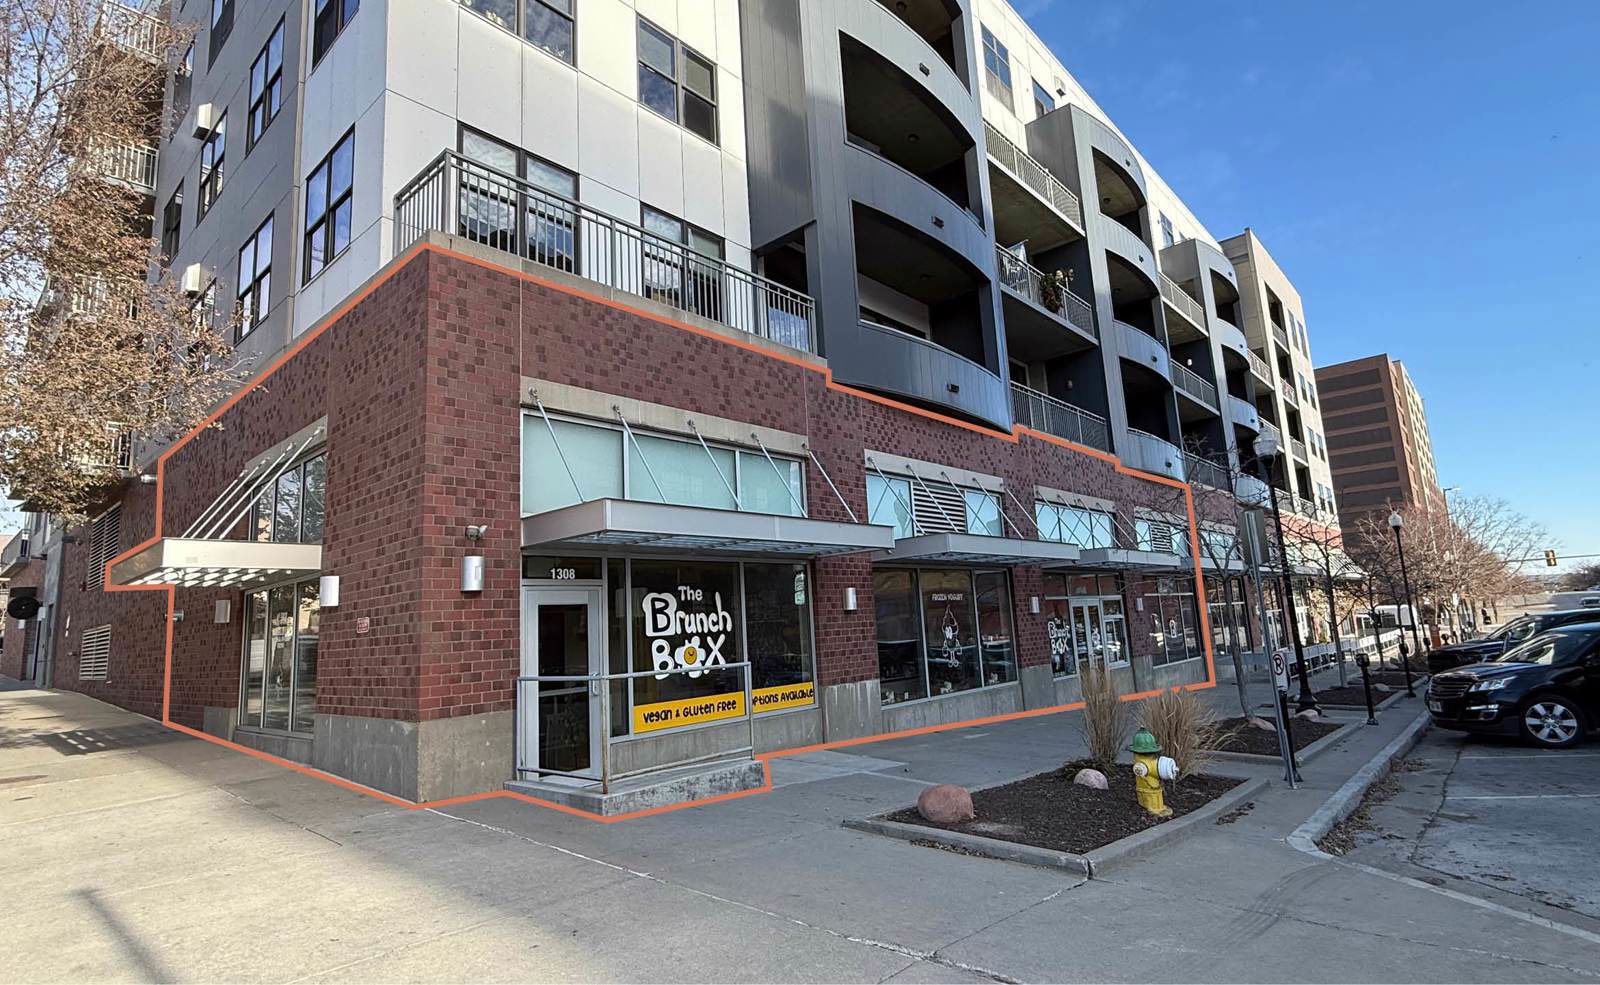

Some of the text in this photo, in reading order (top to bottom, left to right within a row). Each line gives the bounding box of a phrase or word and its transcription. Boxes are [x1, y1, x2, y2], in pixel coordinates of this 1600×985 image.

[550, 568, 576, 579] 1308
[678, 585, 703, 601] The
[643, 592, 732, 637] Brunch
